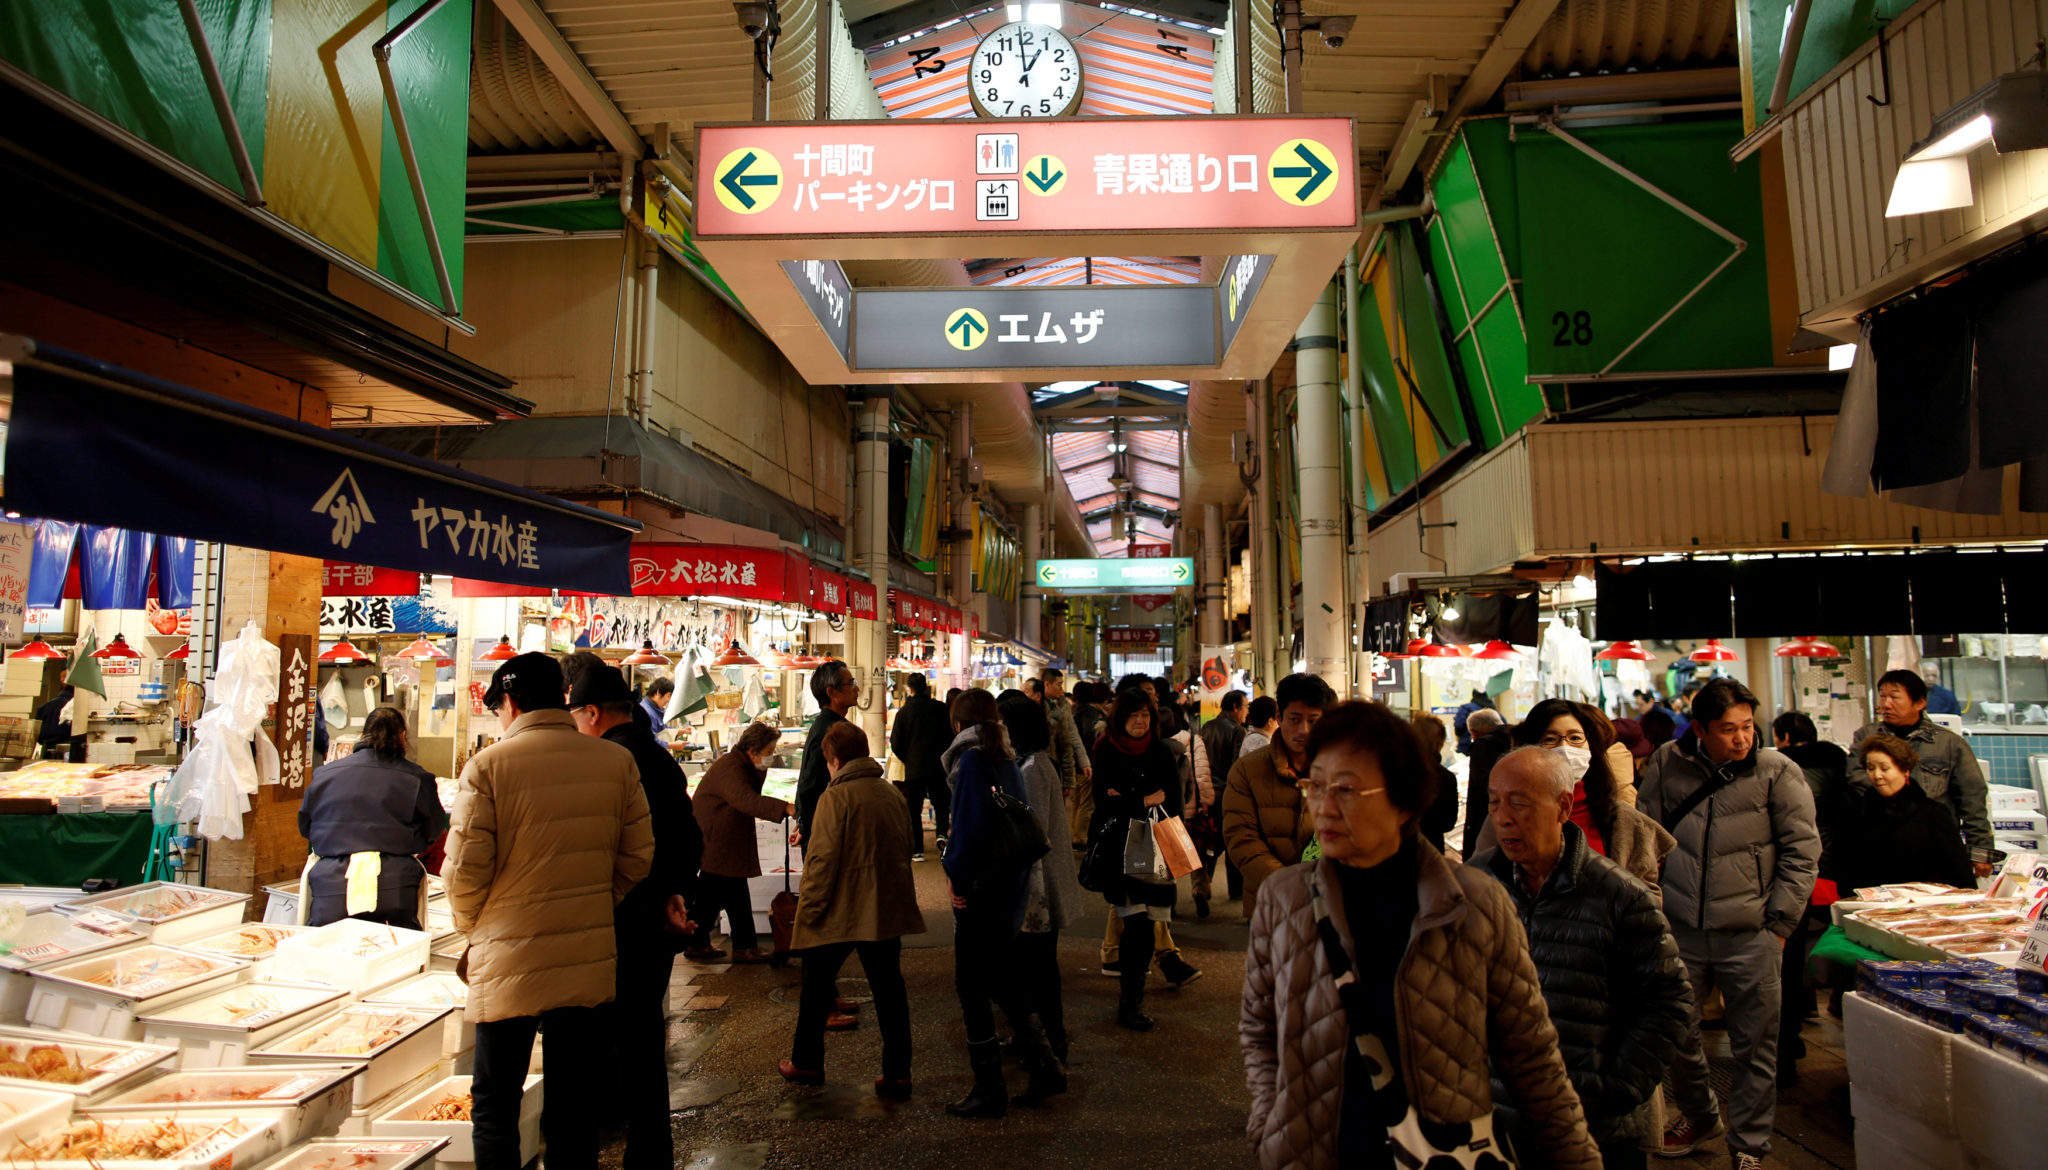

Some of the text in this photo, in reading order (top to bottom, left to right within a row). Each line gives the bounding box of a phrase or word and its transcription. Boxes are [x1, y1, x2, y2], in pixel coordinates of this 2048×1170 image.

[997, 37, 1012, 51] 11
[1015, 31, 1034, 46] 12
[1041, 37, 1049, 51] 1
[908, 46, 946, 79] A2
[984, 52, 1002, 66] 10
[1054, 49, 1065, 62] 2
[981, 69, 992, 83] 9
[1060, 67, 1071, 81] 3
[987, 88, 998, 102] 8
[1053, 86, 1064, 100] 4
[1003, 100, 1014, 114] 7
[1021, 104, 1031, 117] 6
[1040, 99, 1051, 113] 5
[793, 143, 875, 177] 十間町
[1093, 153, 1258, 195] 青果通り口
[793, 178, 955, 212] パーキング口
[998, 309, 1104, 344] エムザ
[1552, 311, 1593, 346] 28
[411, 497, 540, 569] ヤマカ水産
[669, 558, 757, 586] 大松水産
[281, 648, 307, 790] 金沢港
